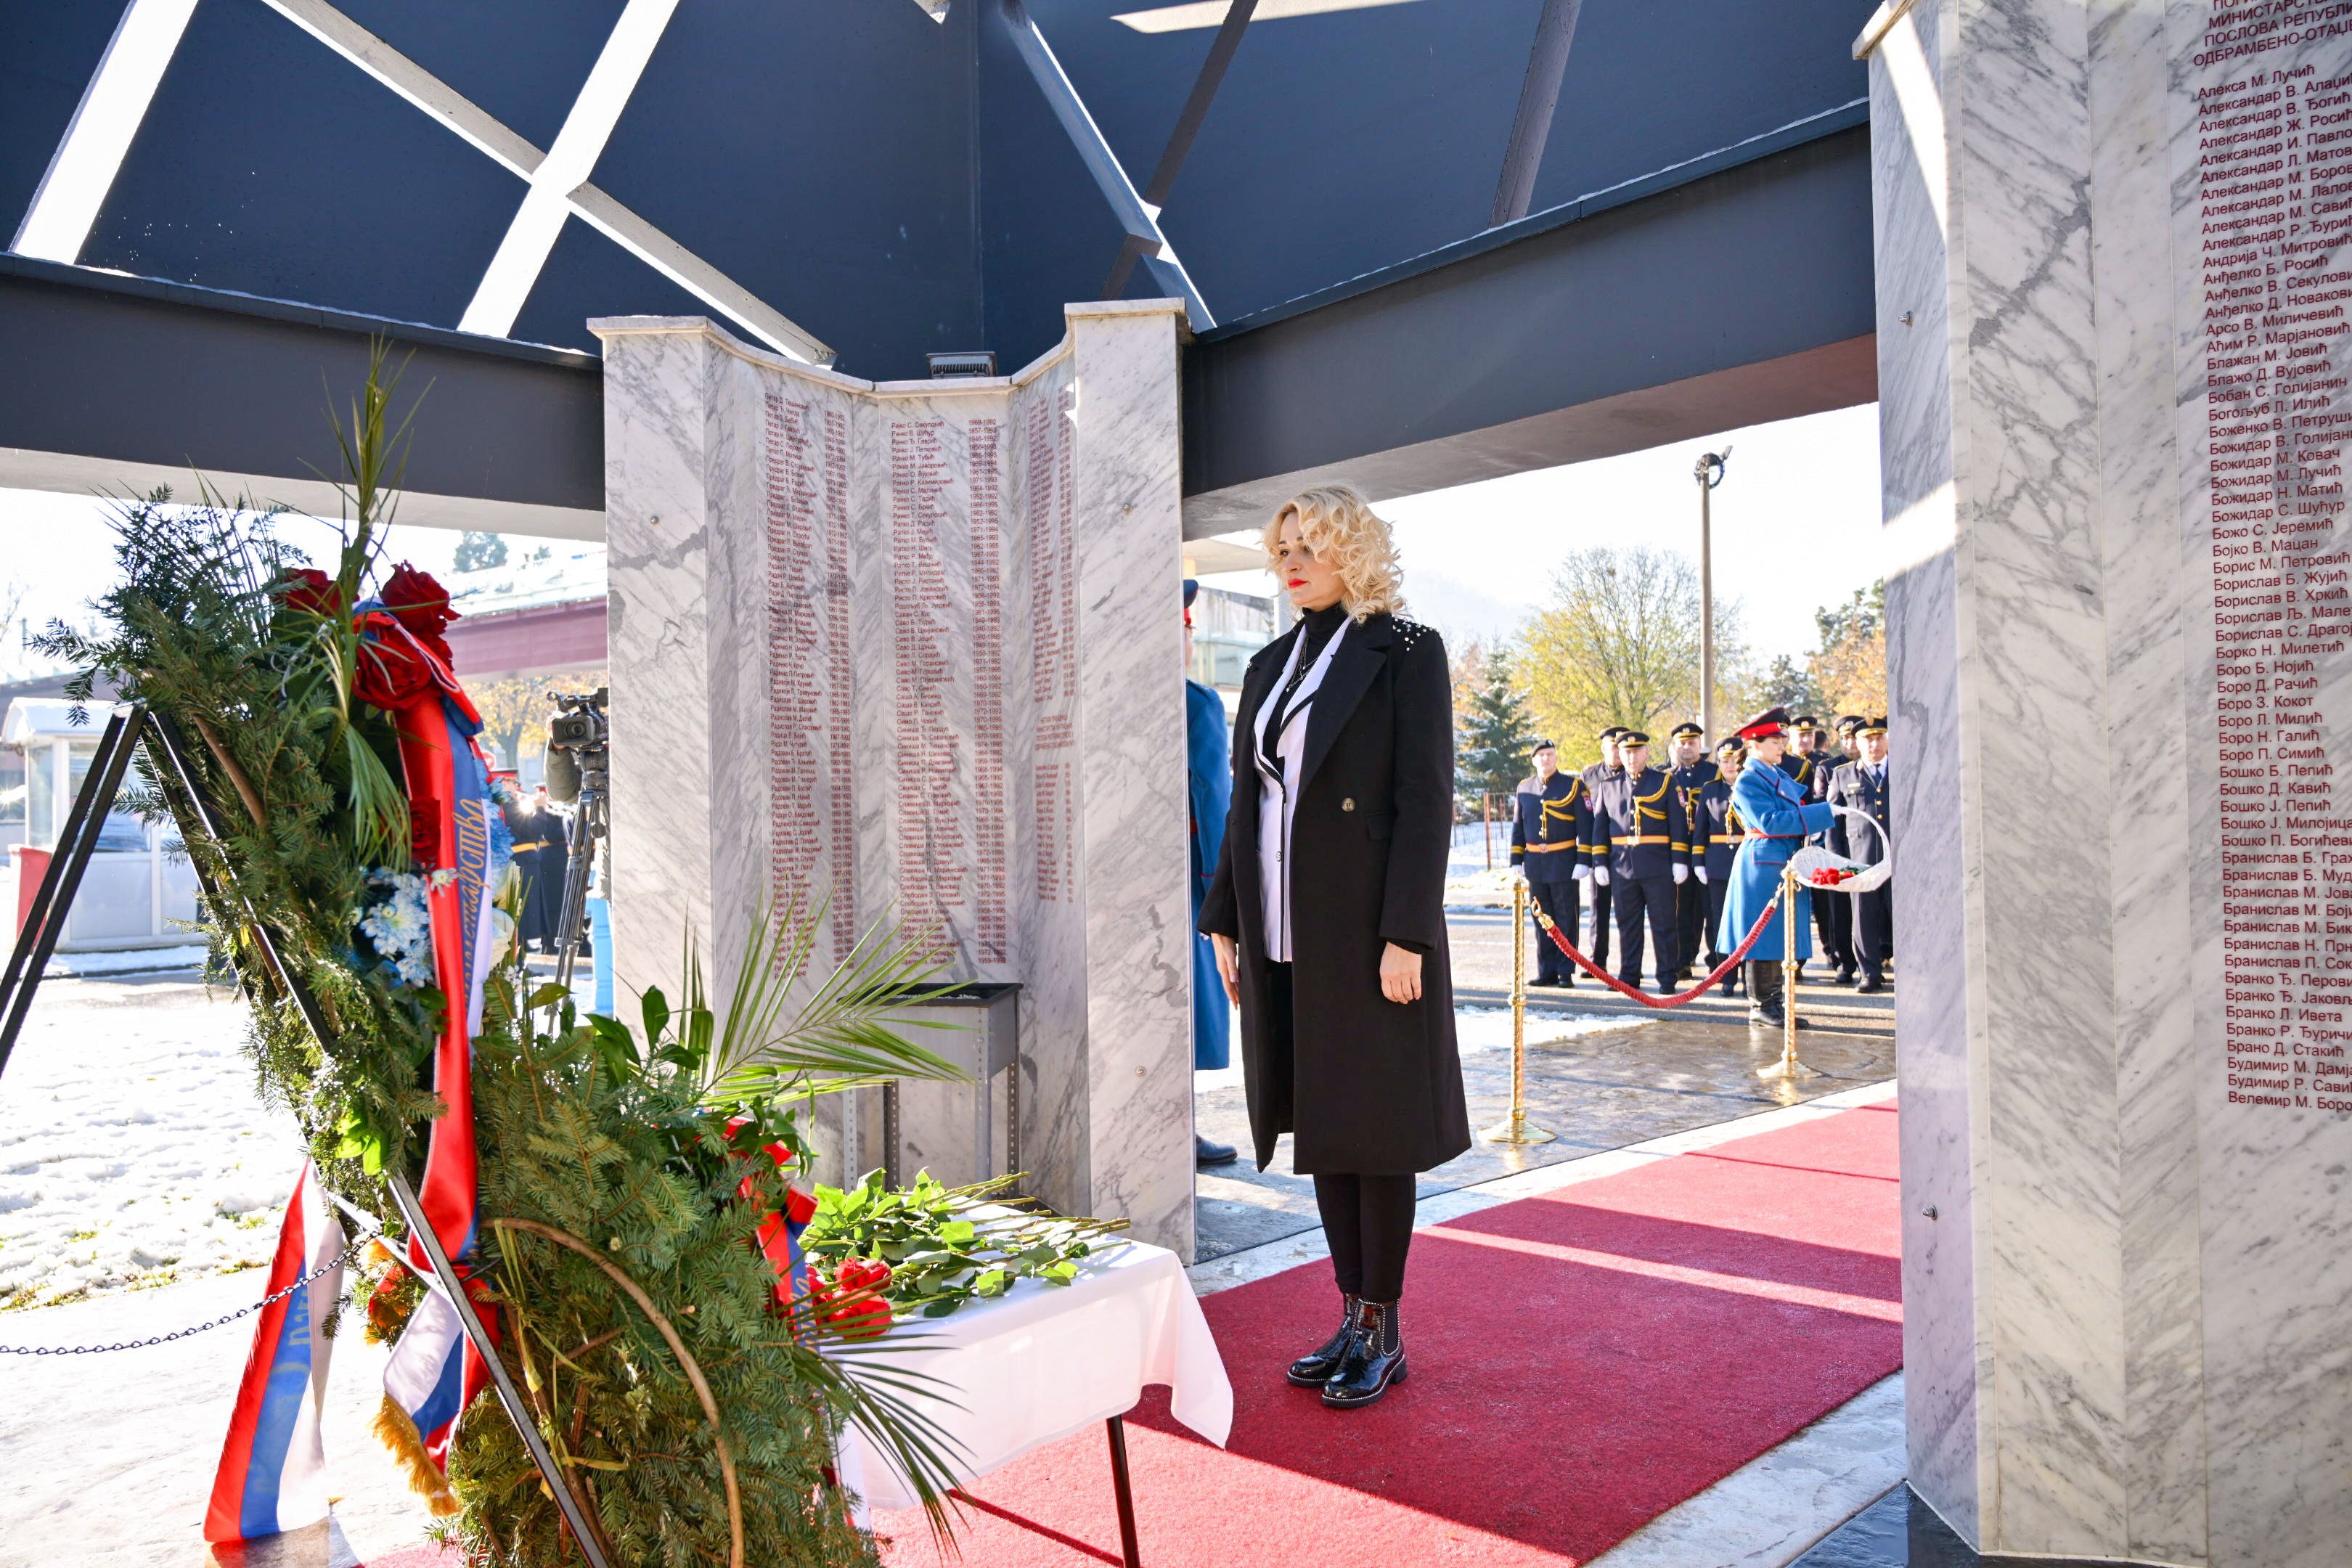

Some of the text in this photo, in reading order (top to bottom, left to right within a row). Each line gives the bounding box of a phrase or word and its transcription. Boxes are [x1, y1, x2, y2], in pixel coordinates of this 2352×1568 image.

[2205, 20, 2279, 48] ПОСЛОВА
[2198, 63, 2316, 100] Алекса М. Лучић
[2198, 91, 2282, 118] Александар
[2199, 91, 2351, 135] Александар В. Ђогић
[2200, 125, 2283, 152] Александар
[2287, 118, 2306, 134] Ж.
[2200, 142, 2284, 168] Александар
[2200, 160, 2284, 186] Александар
[2201, 177, 2284, 203] Александар
[2201, 195, 2285, 220] Александар
[2202, 212, 2284, 236] Александар
[2202, 229, 2286, 253] Александар
[2202, 234, 2352, 270] Андрија Ч. Митровић
[2203, 255, 2329, 286] Анђелко Б. Росић
[2205, 285, 2263, 303] Анђелко
[2203, 302, 2264, 321] Анђелко
[2207, 305, 2344, 338] Арсо В. Миличевић
[2207, 322, 2351, 354] Аћим Р. Марјановић
[2207, 342, 2328, 372] Блажан М. Јовић
[2207, 359, 2332, 388] Блажо Д. Вујовић
[2209, 377, 2348, 405] Бобан С. Голијанин
[2208, 395, 2331, 423] Богољуб Л. Илић
[2209, 422, 2271, 440] Боженко
[2210, 439, 2271, 457] Божидар
[2210, 449, 2341, 473] Божидар М. Ковач
[2211, 464, 2343, 491] Божидар М. Лучић
[2211, 481, 2343, 507] Божидар Н. Матић
[2211, 500, 2345, 524] Божидар С. Шућур
[2211, 518, 2334, 541] Божо С. Јеремић
[2213, 539, 2319, 559] Бојко В. Мацан
[2213, 551, 2351, 576] Борис М. Петровић
[2214, 569, 2348, 593] Борислав Б. Жујић
[2214, 587, 2348, 609] Борислав В. Хркић
[2215, 611, 2283, 626] Борислав
[2216, 629, 2284, 643] Борислав
[2216, 640, 2345, 661] Борко Н. Милетић
[2216, 659, 2315, 678] Боро Б. Нојић
[2218, 677, 2318, 696] Боро Д. Рачић
[2218, 695, 2314, 712] Боро З. Кокот
[2218, 711, 2324, 730] Боро Л. Милић
[2218, 729, 2322, 746] Боро Н. Галић
[2218, 746, 2327, 762] Боро П. Симић
[2220, 763, 2334, 780] Бошко Б. Пепић
[2218, 781, 2332, 797] Бошко Д. Кавић
[2220, 799, 2332, 814] Бошко Ј. Пепић
[2220, 817, 2266, 831] Бошко
[2221, 833, 2267, 848] Бошко
[2221, 851, 2299, 867] Бранислав
[2223, 867, 2299, 882] Бранислав
[2223, 885, 2300, 900] Бранислав
[2224, 971, 2275, 987] Бранко
[2225, 987, 2276, 1003] Бранко
[2226, 1005, 2344, 1024] Бранко Л. Ивета
[2226, 1021, 2277, 1037] Бранко
[2227, 1039, 2345, 1058] Брано Д. Стакић
[2227, 1056, 2289, 1075] Будимир
[2228, 1073, 2290, 1093] Будимир
[2228, 1090, 2292, 1111] Велемир
